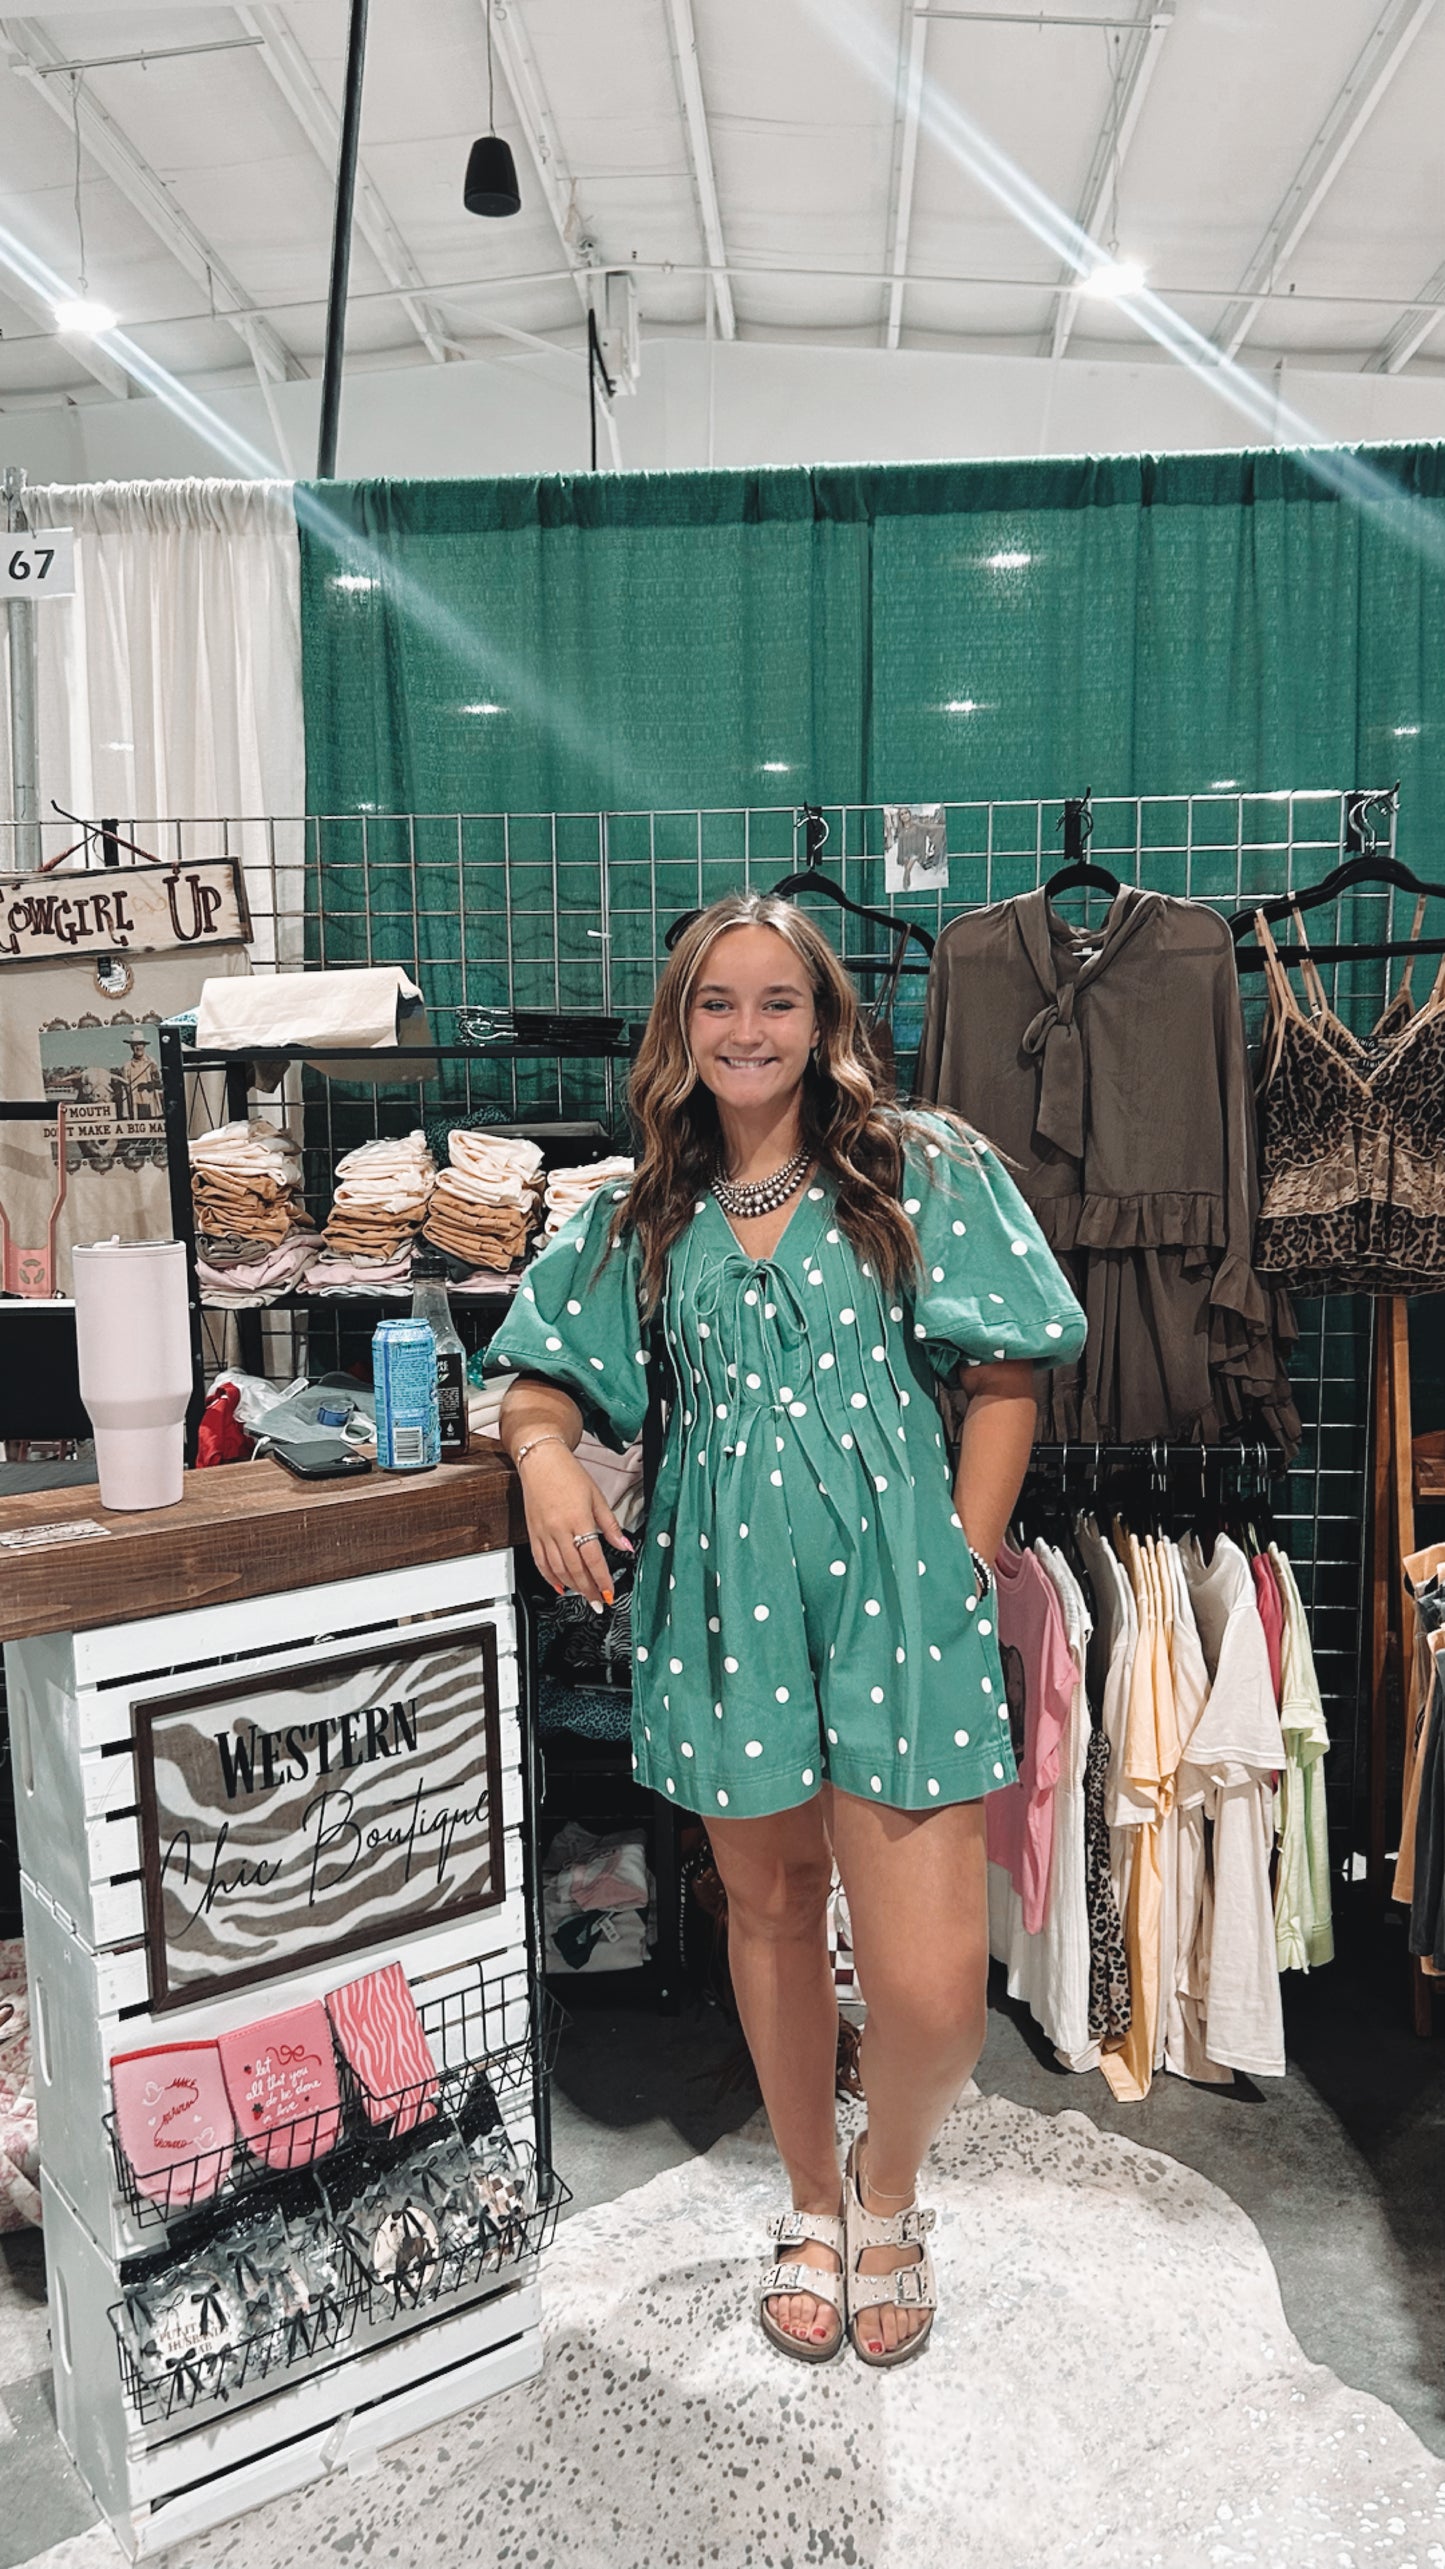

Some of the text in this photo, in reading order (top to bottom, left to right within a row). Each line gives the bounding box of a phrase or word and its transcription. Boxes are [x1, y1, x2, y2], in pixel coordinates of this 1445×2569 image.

[8, 549, 55, 580] 67
[69, 1106, 111, 1118] MOUTH
[44, 1121, 166, 1138] DOT MAKE A BIG MA
[214, 1697, 419, 1799] WESTERN
[303, 1777, 490, 1907] Boutique
[255, 2056, 272, 2077] let
[245, 2066, 309, 2101] all that you
[265, 2091, 278, 2108] do
[295, 2078, 322, 2095] done
